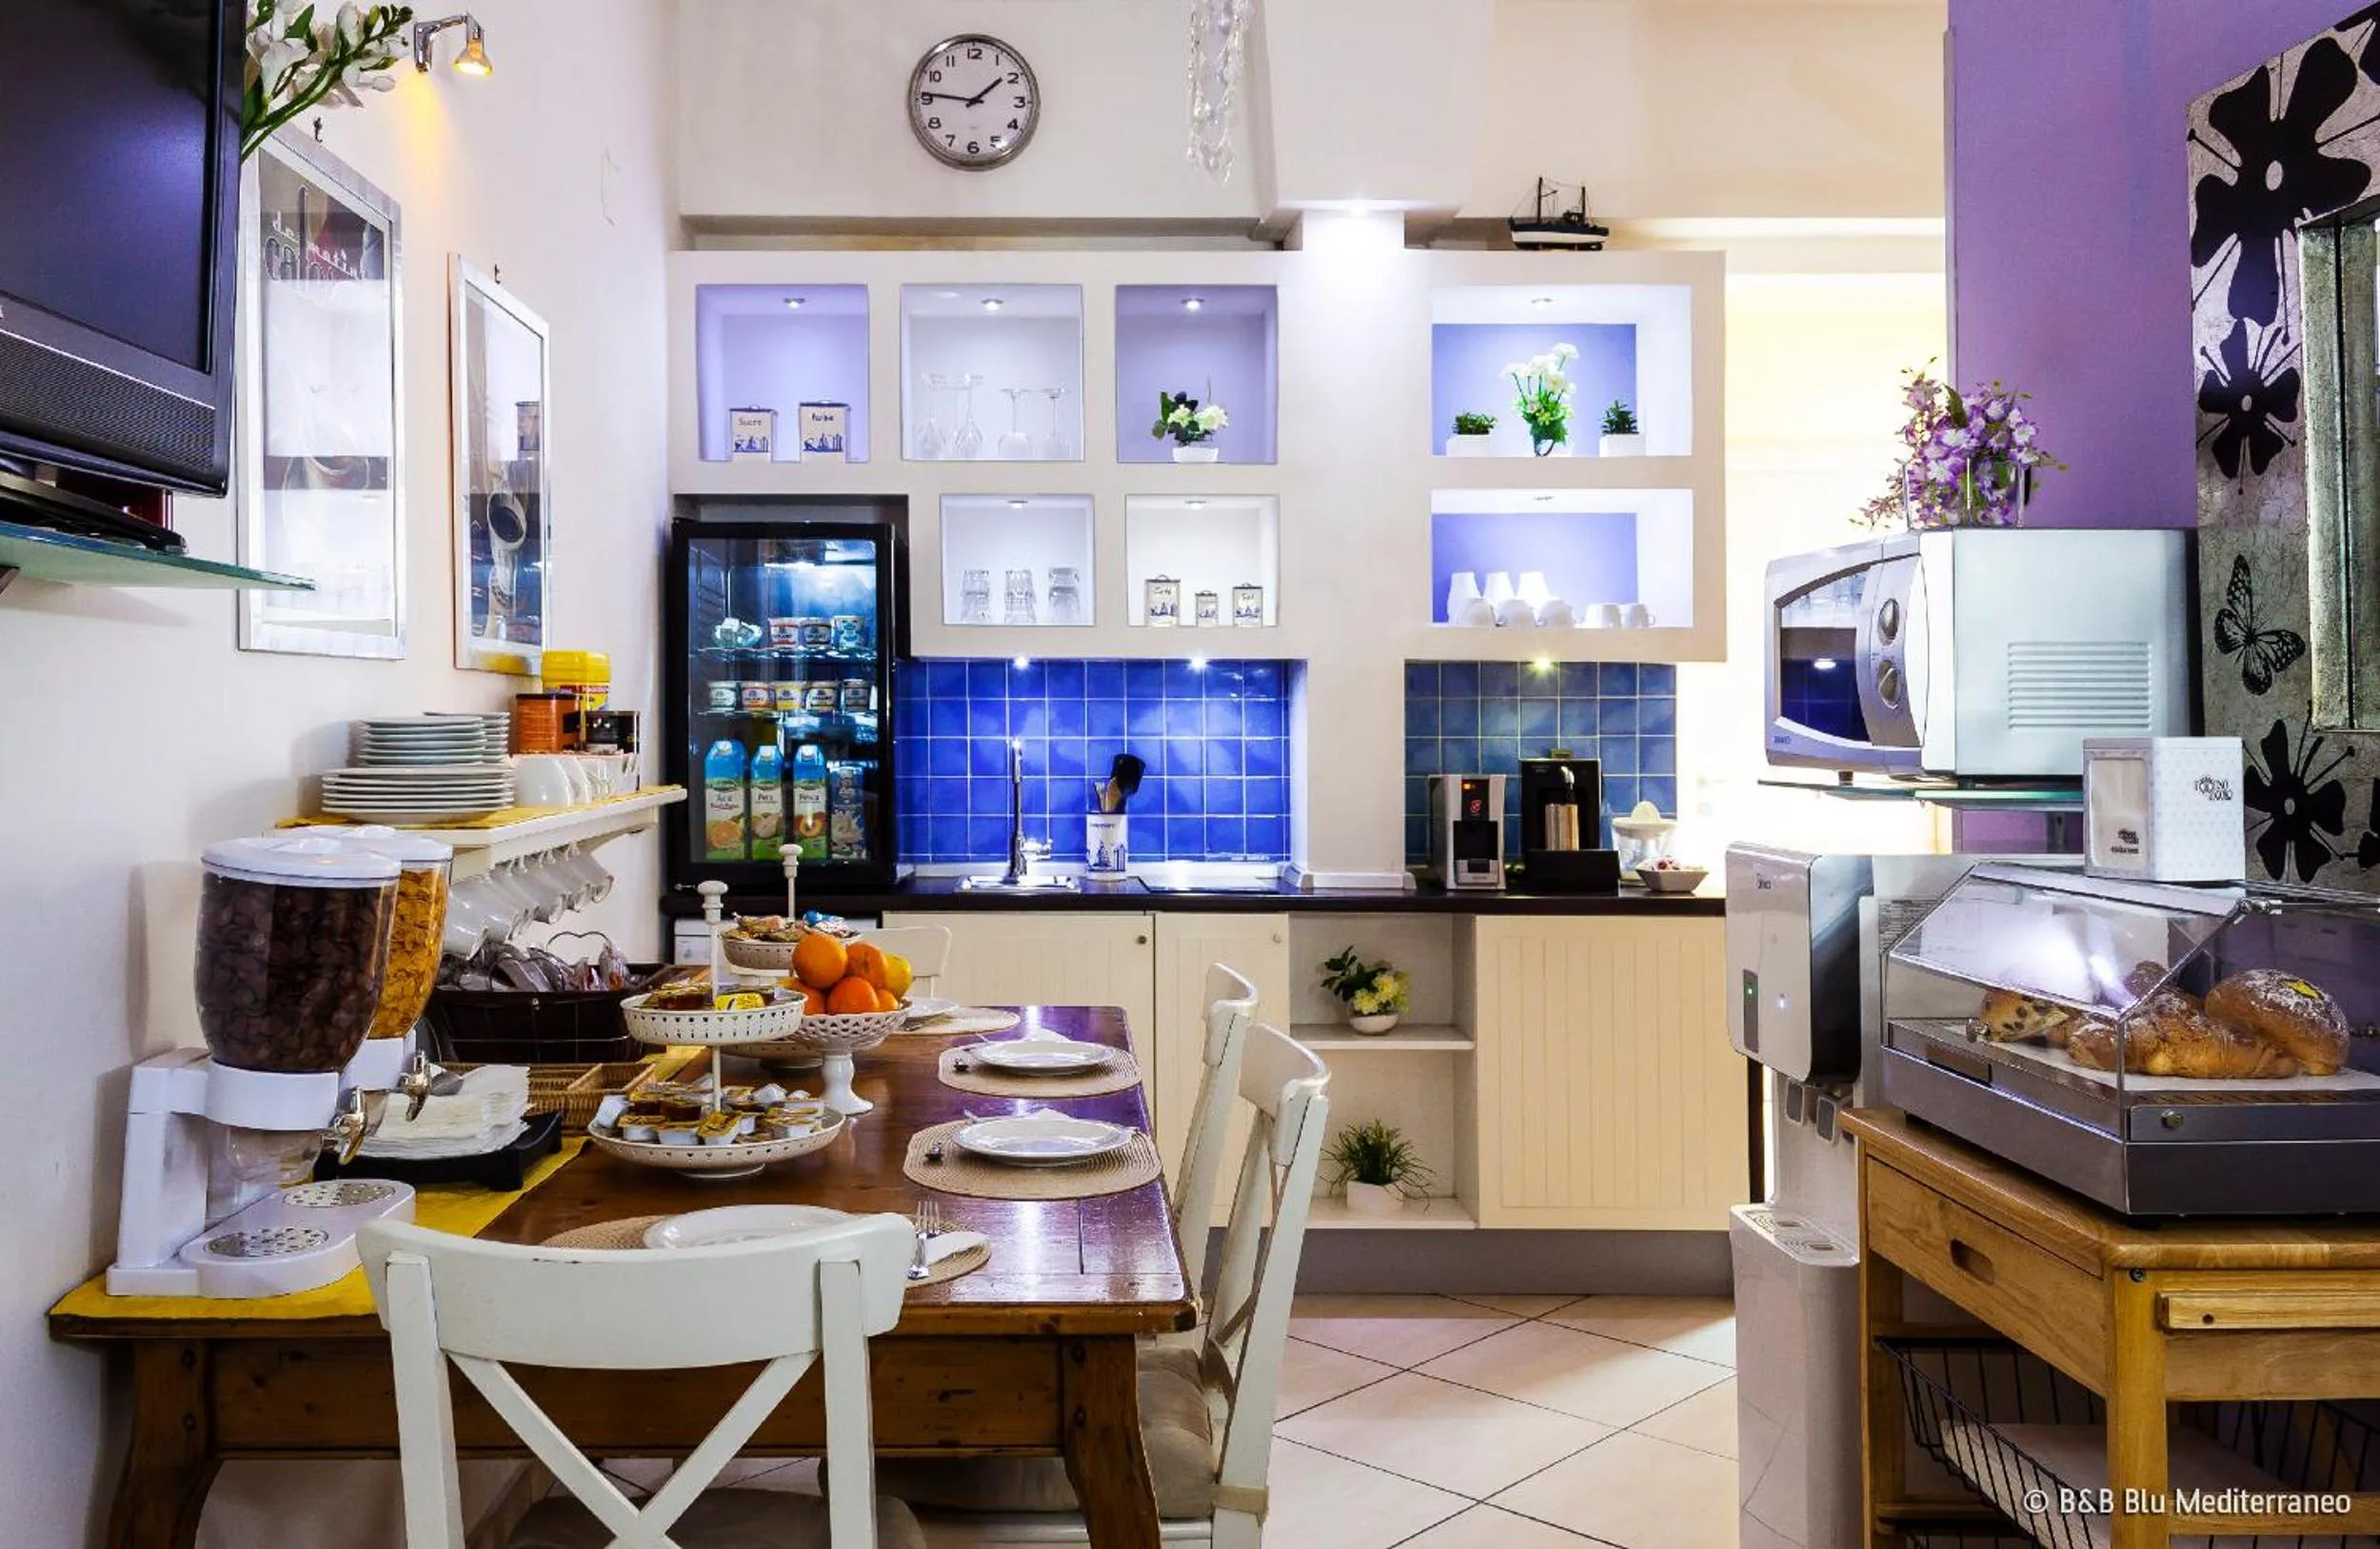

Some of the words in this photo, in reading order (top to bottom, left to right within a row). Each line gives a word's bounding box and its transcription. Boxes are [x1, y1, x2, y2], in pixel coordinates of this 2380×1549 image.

[945, 54, 955, 68] 11
[966, 49, 982, 60] 12
[928, 70, 942, 83] 10
[1006, 72, 1020, 84] 2
[921, 91, 934, 106] 9
[1013, 96, 1026, 109] 3
[927, 117, 942, 129] 8
[1006, 118, 1019, 130] 4
[944, 134, 956, 148] 7
[966, 141, 981, 154] 6
